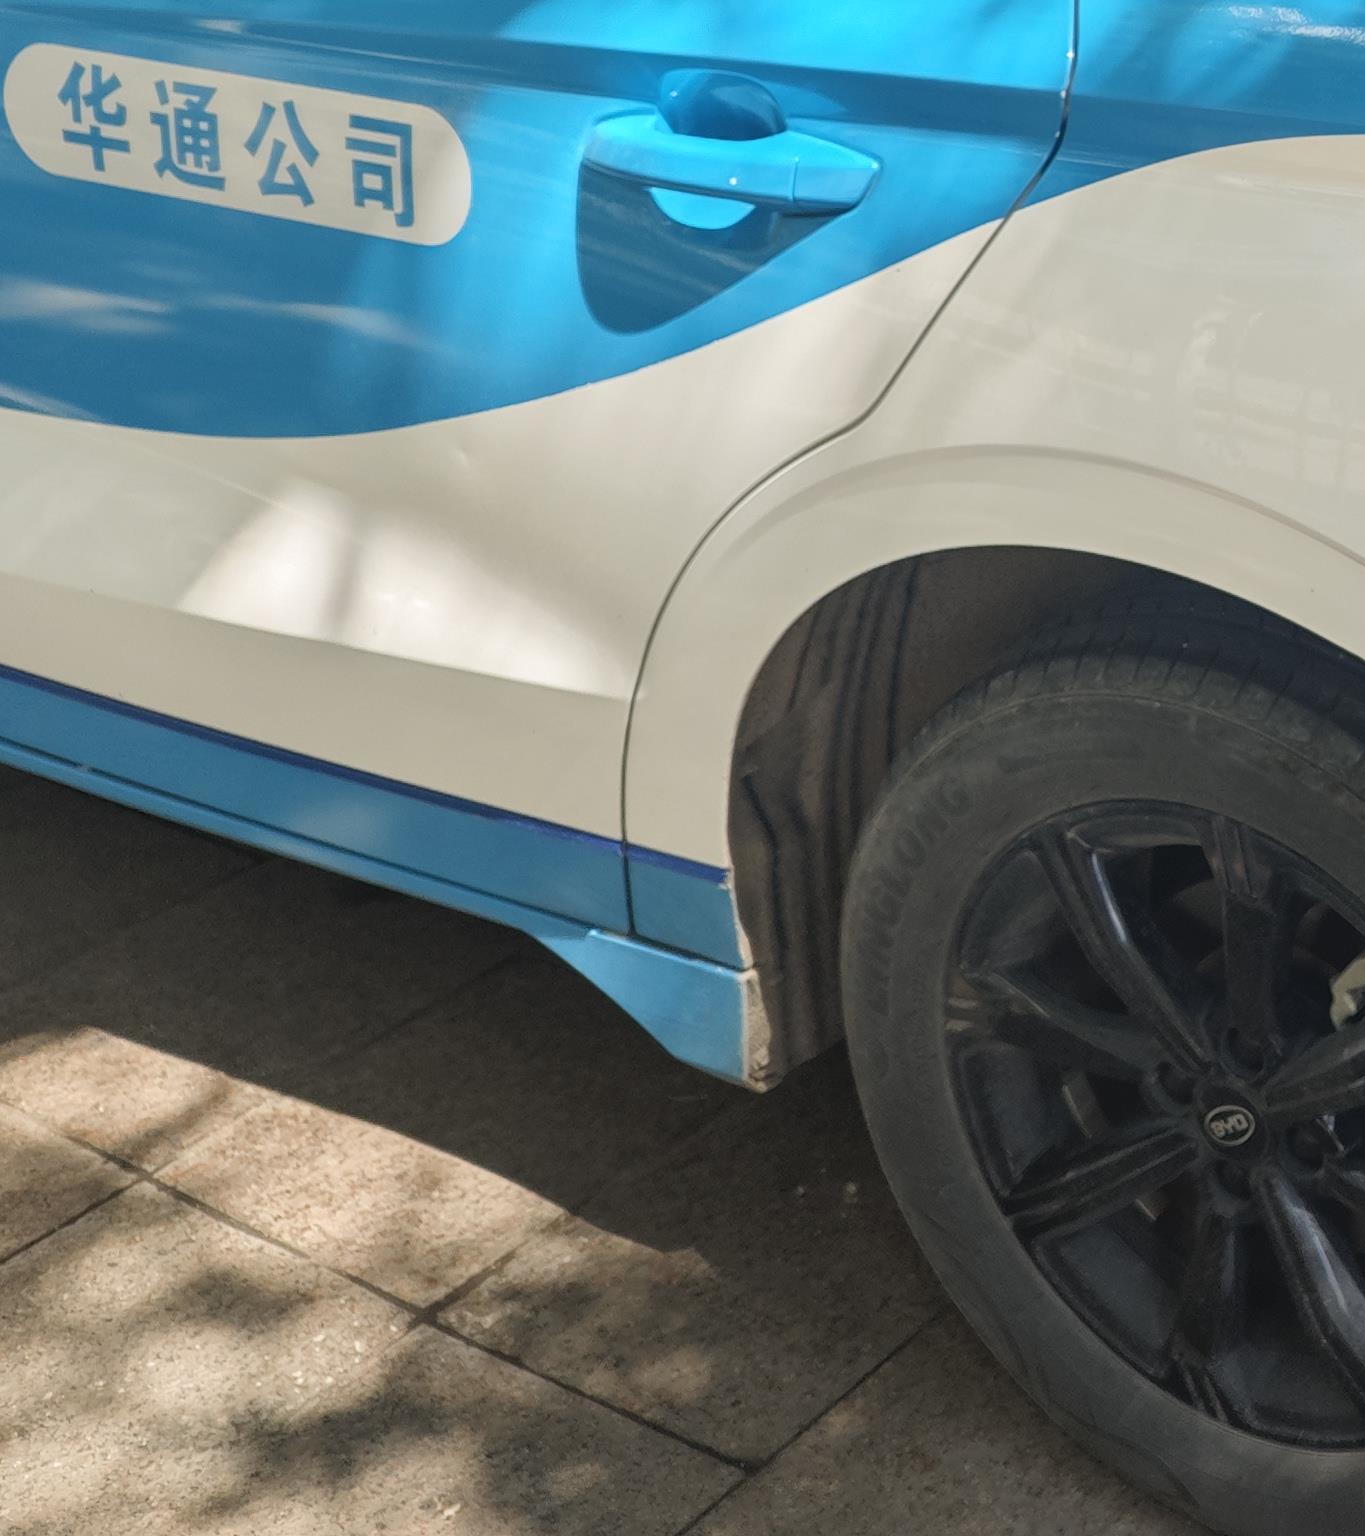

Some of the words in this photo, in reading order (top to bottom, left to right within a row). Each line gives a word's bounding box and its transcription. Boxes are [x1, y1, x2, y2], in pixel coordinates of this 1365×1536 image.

[57, 61, 415, 228] 华通公司
[1210, 1113, 1249, 1138] BYD
